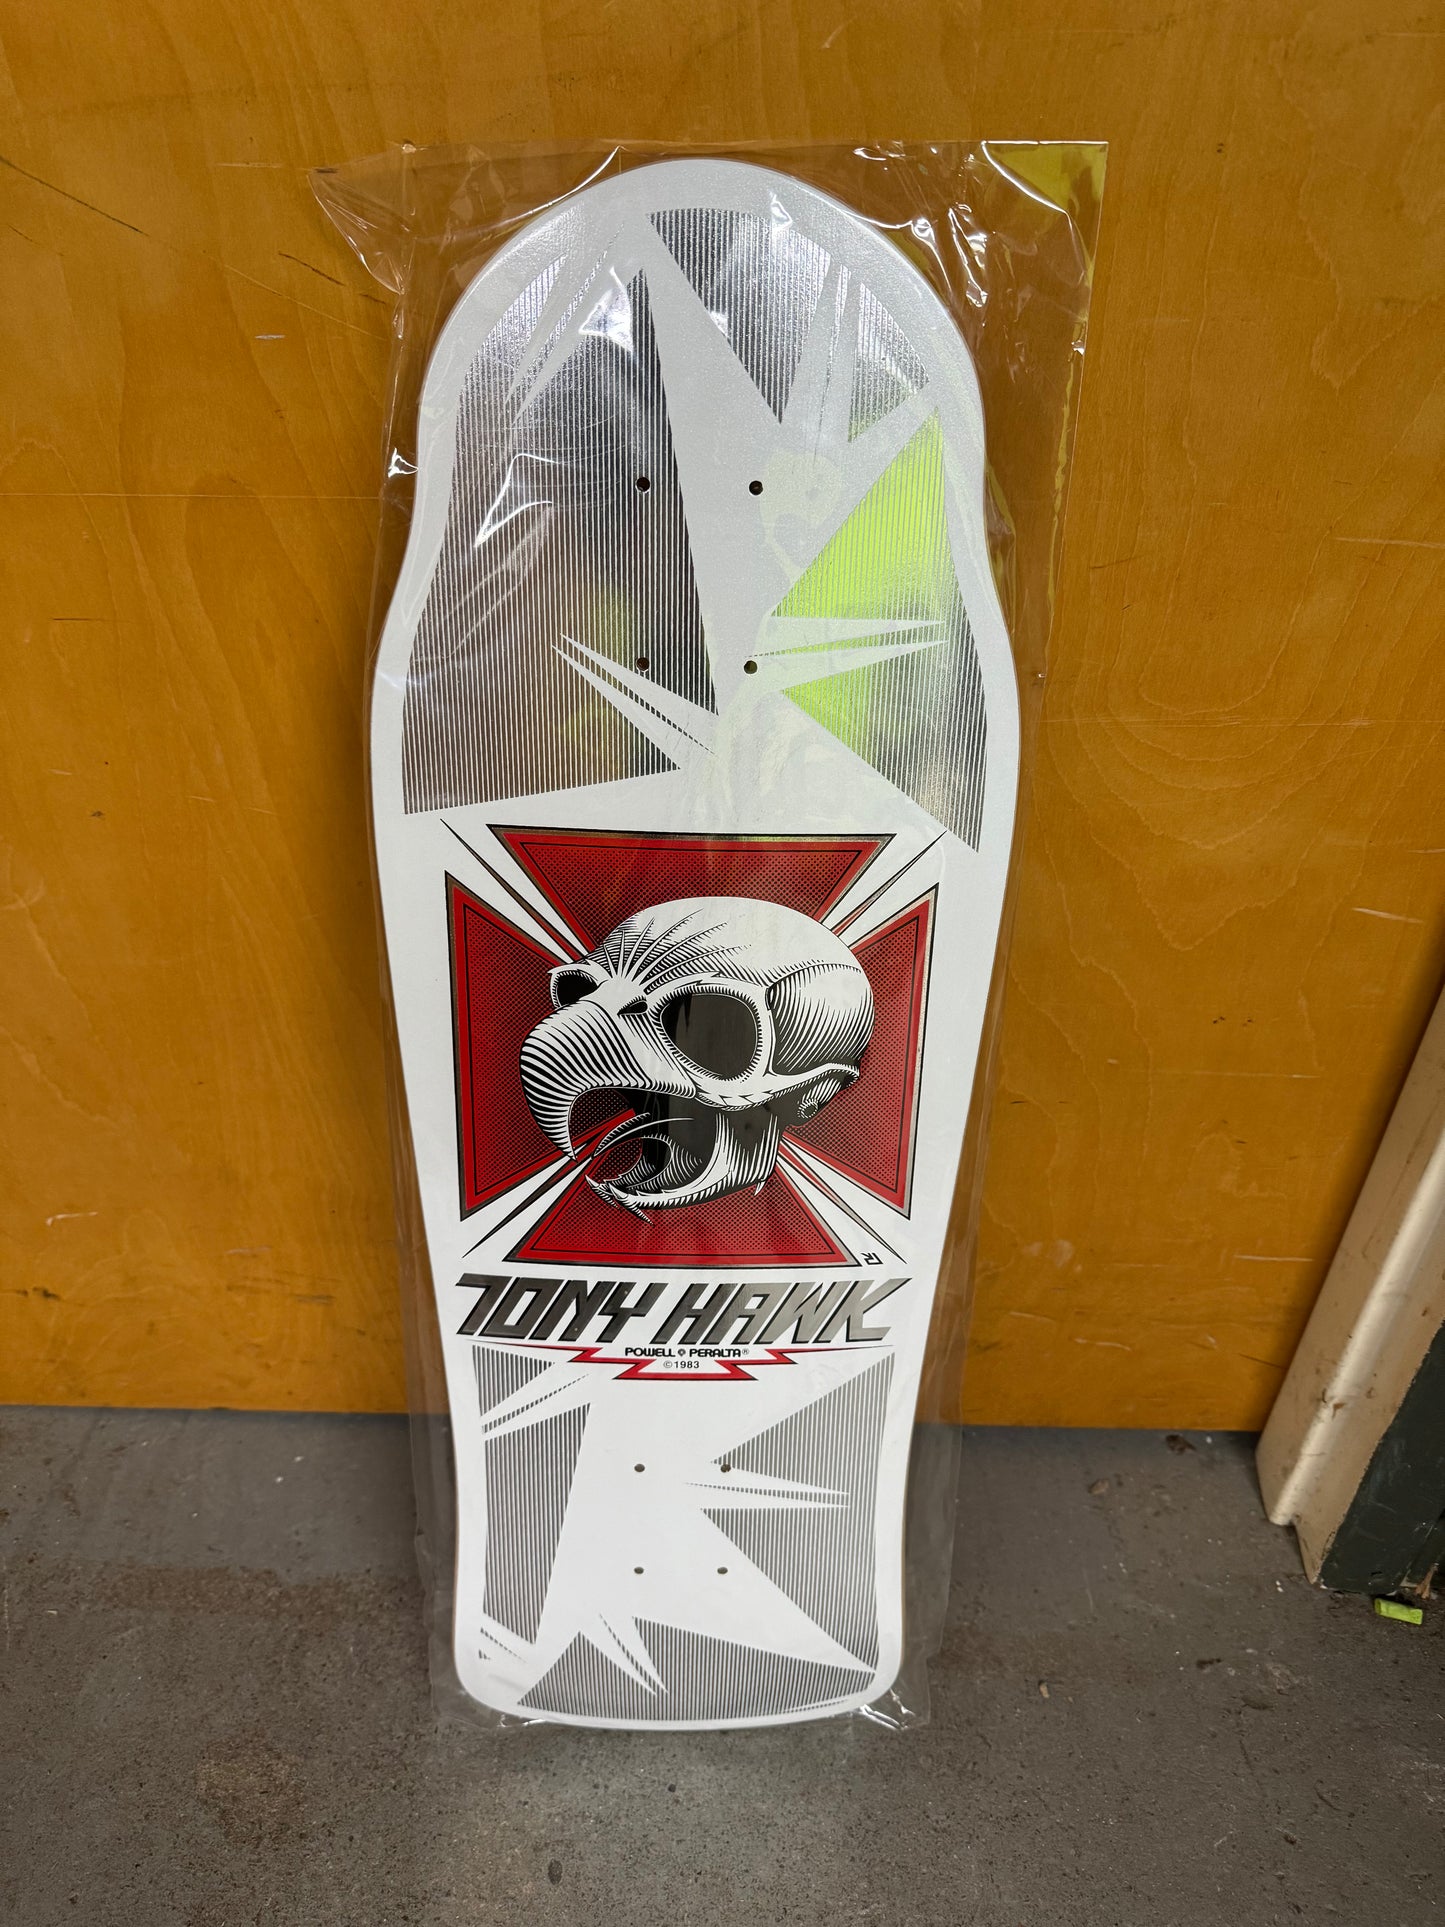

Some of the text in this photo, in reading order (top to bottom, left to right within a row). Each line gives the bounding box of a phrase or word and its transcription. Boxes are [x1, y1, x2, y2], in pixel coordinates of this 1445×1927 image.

[455, 1272, 913, 1344] TONY HAWK
[624, 1346, 676, 1358] POWELL
